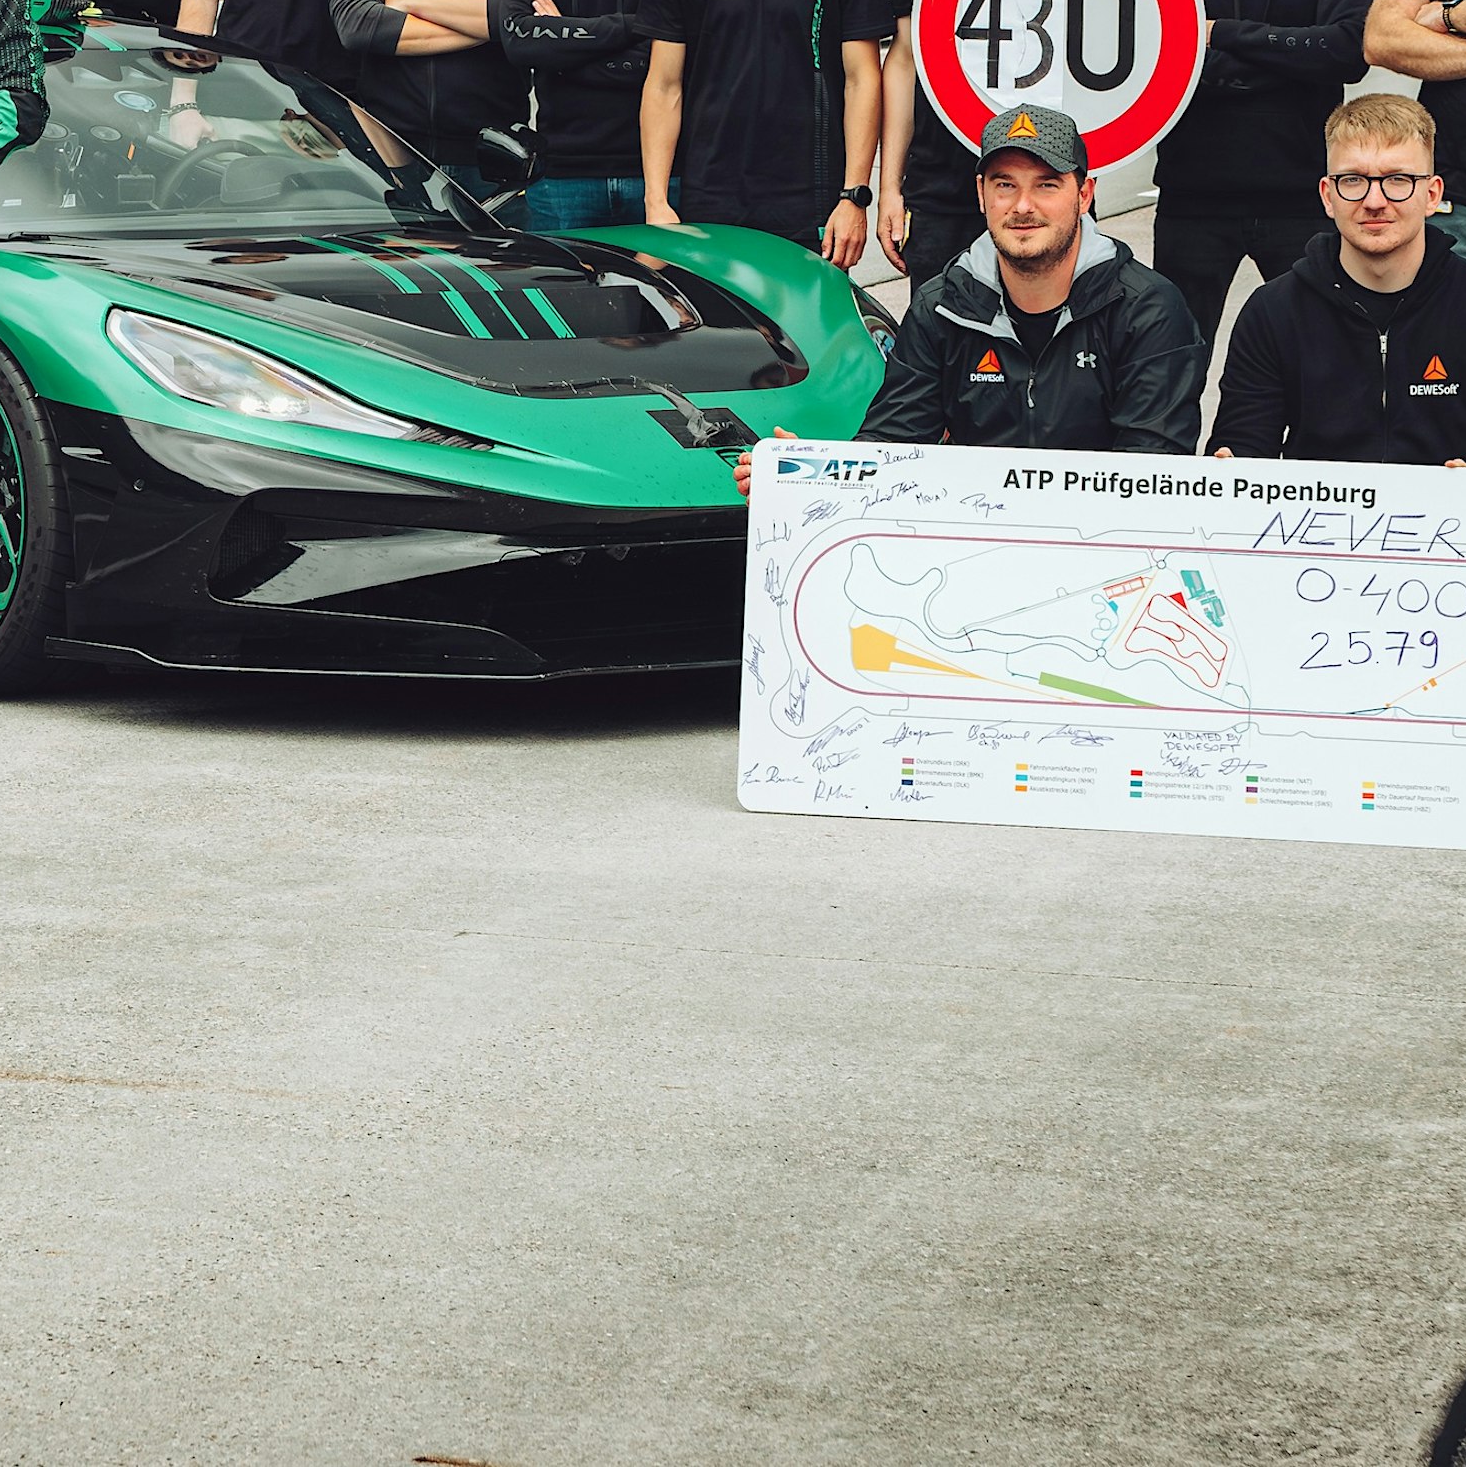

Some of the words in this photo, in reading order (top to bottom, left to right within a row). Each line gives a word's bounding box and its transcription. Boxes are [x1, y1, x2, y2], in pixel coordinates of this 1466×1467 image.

[969, 373, 1005, 383] DEWESoft
[1409, 383, 1458, 396] DEWESoft
[824, 459, 879, 481] ATP
[1003, 469, 1054, 490] ATP
[1063, 470, 1223, 498] Prüfgelände
[1233, 478, 1377, 509] Papenburg
[1300, 630, 1439, 670] 25.79
[1163, 731, 1223, 742] VALIDATED
[1227, 733, 1244, 744] BY
[1163, 741, 1242, 753] DEWESOFT
